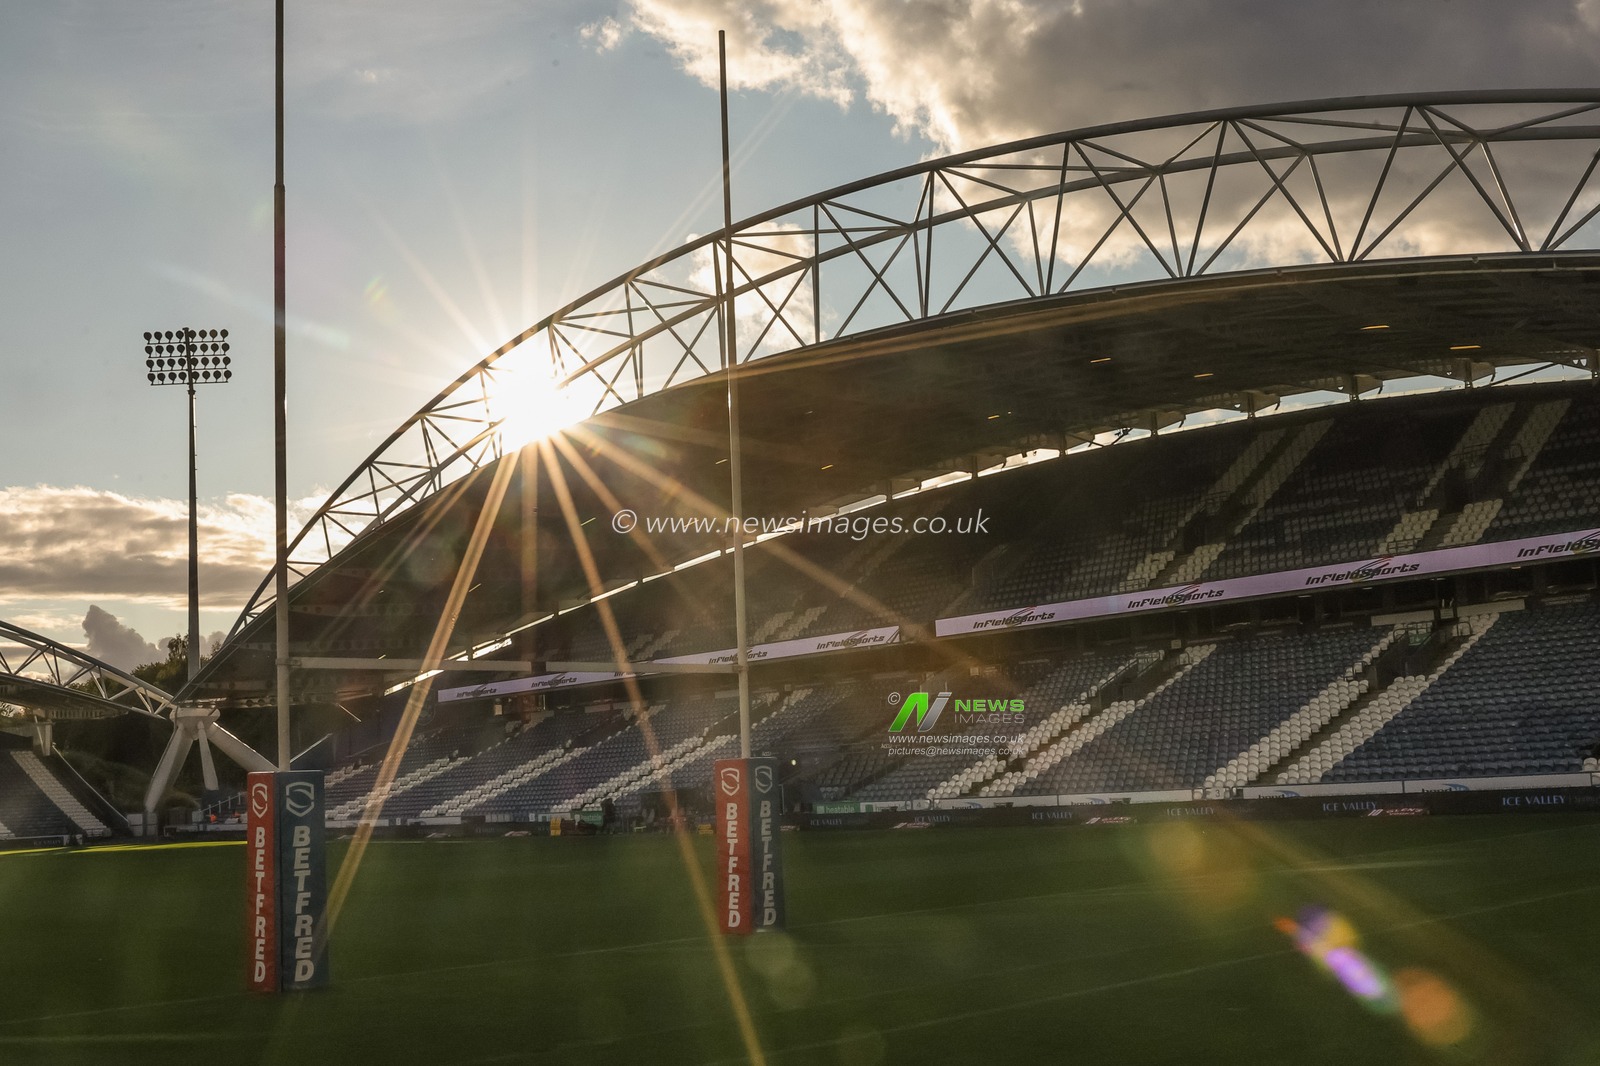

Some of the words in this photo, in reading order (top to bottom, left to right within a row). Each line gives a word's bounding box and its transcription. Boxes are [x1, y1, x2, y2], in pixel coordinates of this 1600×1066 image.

[1127, 588, 1225, 609] InFieldSports
[1305, 563, 1420, 586] InFieldSports
[1322, 802, 1339, 812] ICE
[1342, 801, 1377, 810] VALLEY
[1502, 796, 1520, 806] ICE
[1525, 794, 1566, 805] VALLEY
[725, 802, 741, 928] BETFRED
[759, 800, 777, 926] BETFRED
[255, 826, 266, 983] BETFRED
[292, 825, 315, 982] BETFRED
